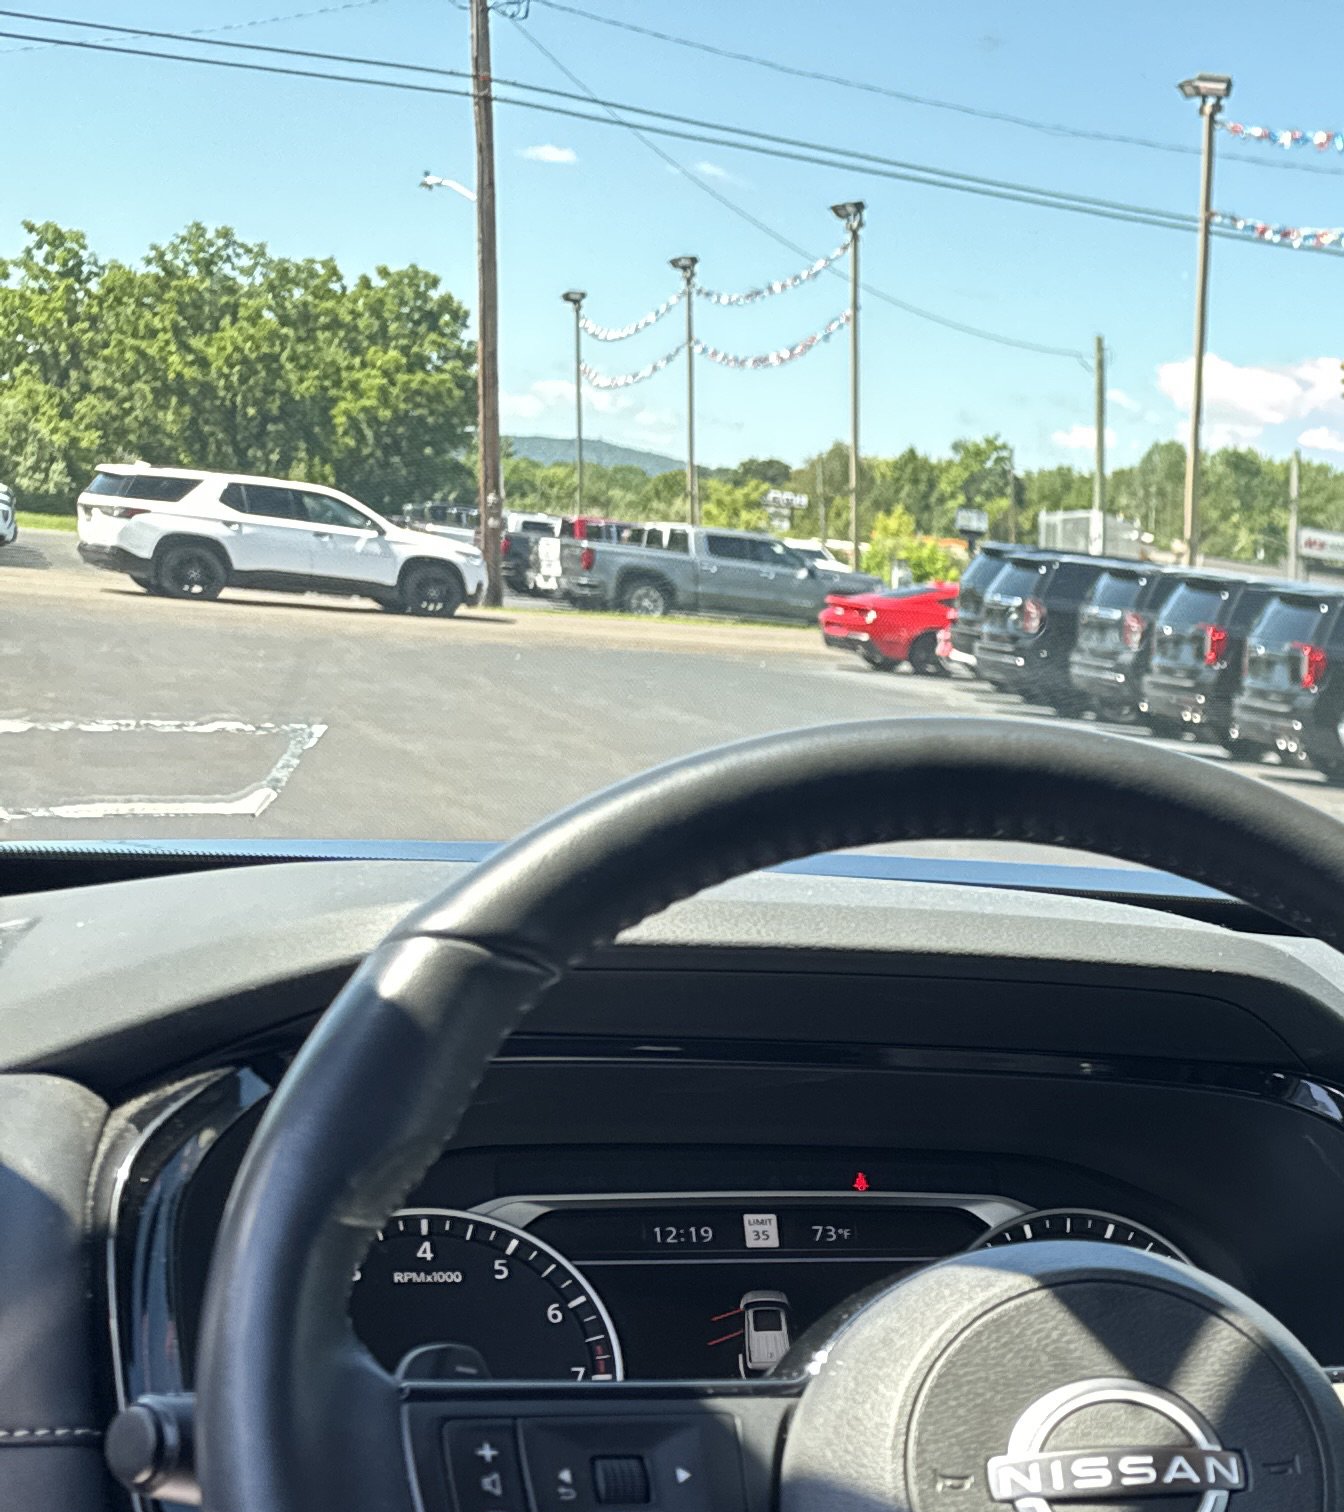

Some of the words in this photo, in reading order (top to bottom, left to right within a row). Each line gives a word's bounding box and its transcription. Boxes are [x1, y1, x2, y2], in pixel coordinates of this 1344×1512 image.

[747, 1218, 773, 1227] LIMIT
[653, 1226, 714, 1244] 12:19
[752, 1229, 770, 1241] 35
[811, 1225, 851, 1242] 73°F
[416, 1241, 434, 1261] 4
[493, 1259, 509, 1280] 5
[546, 1303, 564, 1324] 6
[570, 1366, 586, 1382] 7
[999, 1455, 1241, 1498] NISSAN
